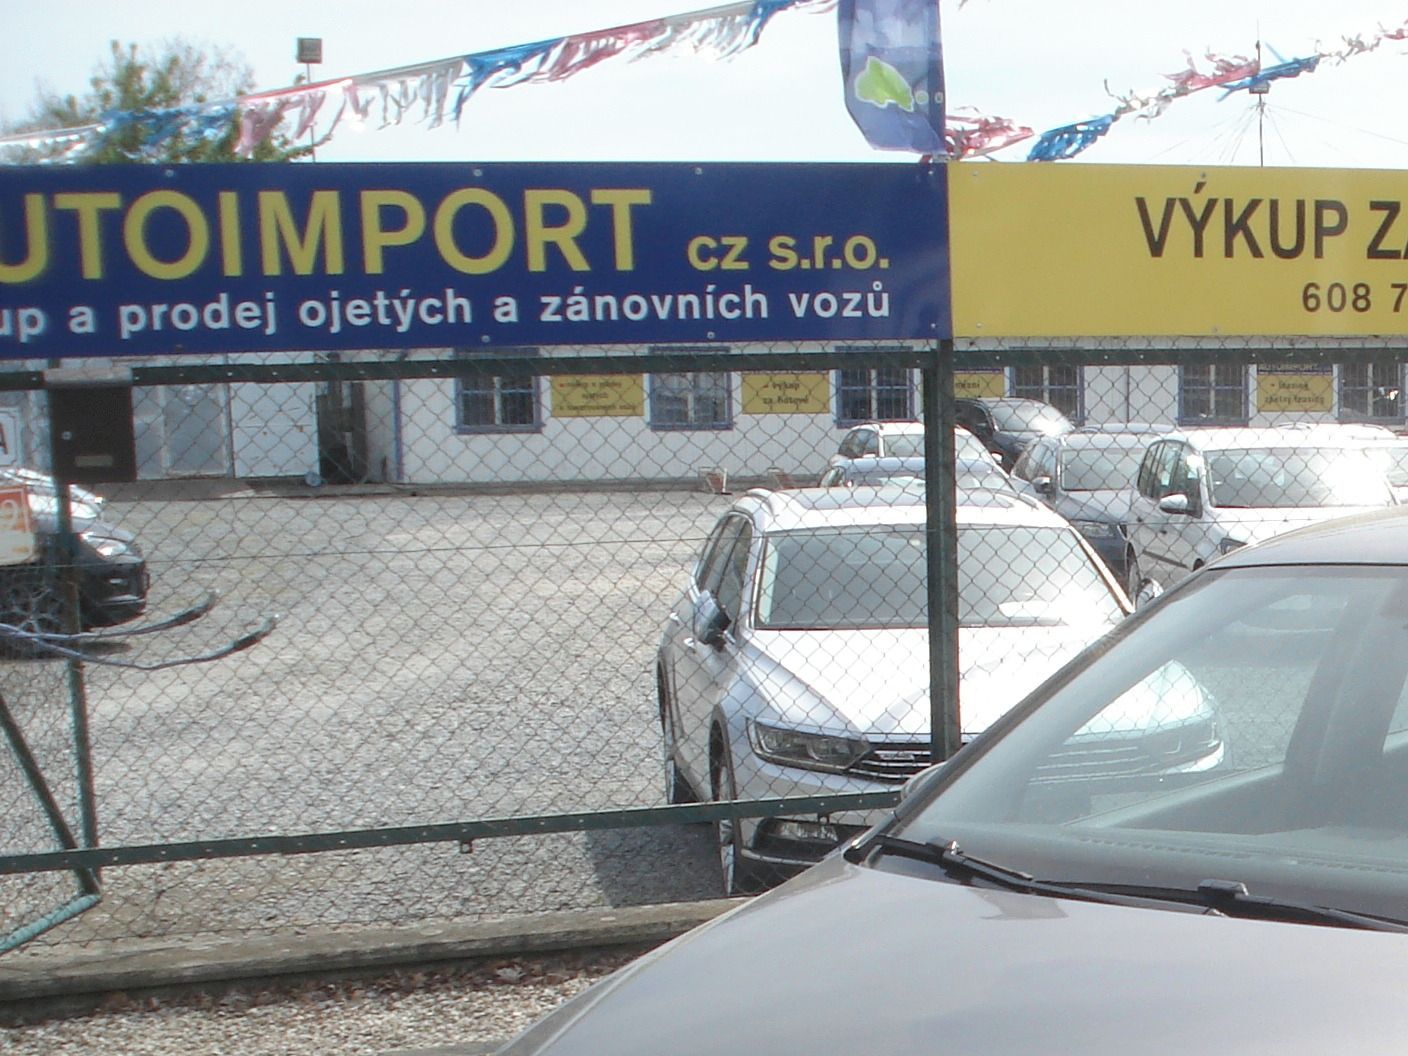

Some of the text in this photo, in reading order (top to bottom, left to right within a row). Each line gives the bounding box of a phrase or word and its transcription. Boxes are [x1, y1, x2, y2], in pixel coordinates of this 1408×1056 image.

[1135, 181, 1348, 259] VÝKUP
[688, 236, 749, 270] cz
[769, 235, 889, 270] s.r.o.
[69, 304, 96, 333] a
[119, 292, 277, 339] prodej
[299, 289, 472, 333] ojetých
[494, 296, 518, 322] a
[540, 285, 768, 323] zánovních
[789, 281, 889, 318] vozů
[1302, 282, 1371, 313] 608
